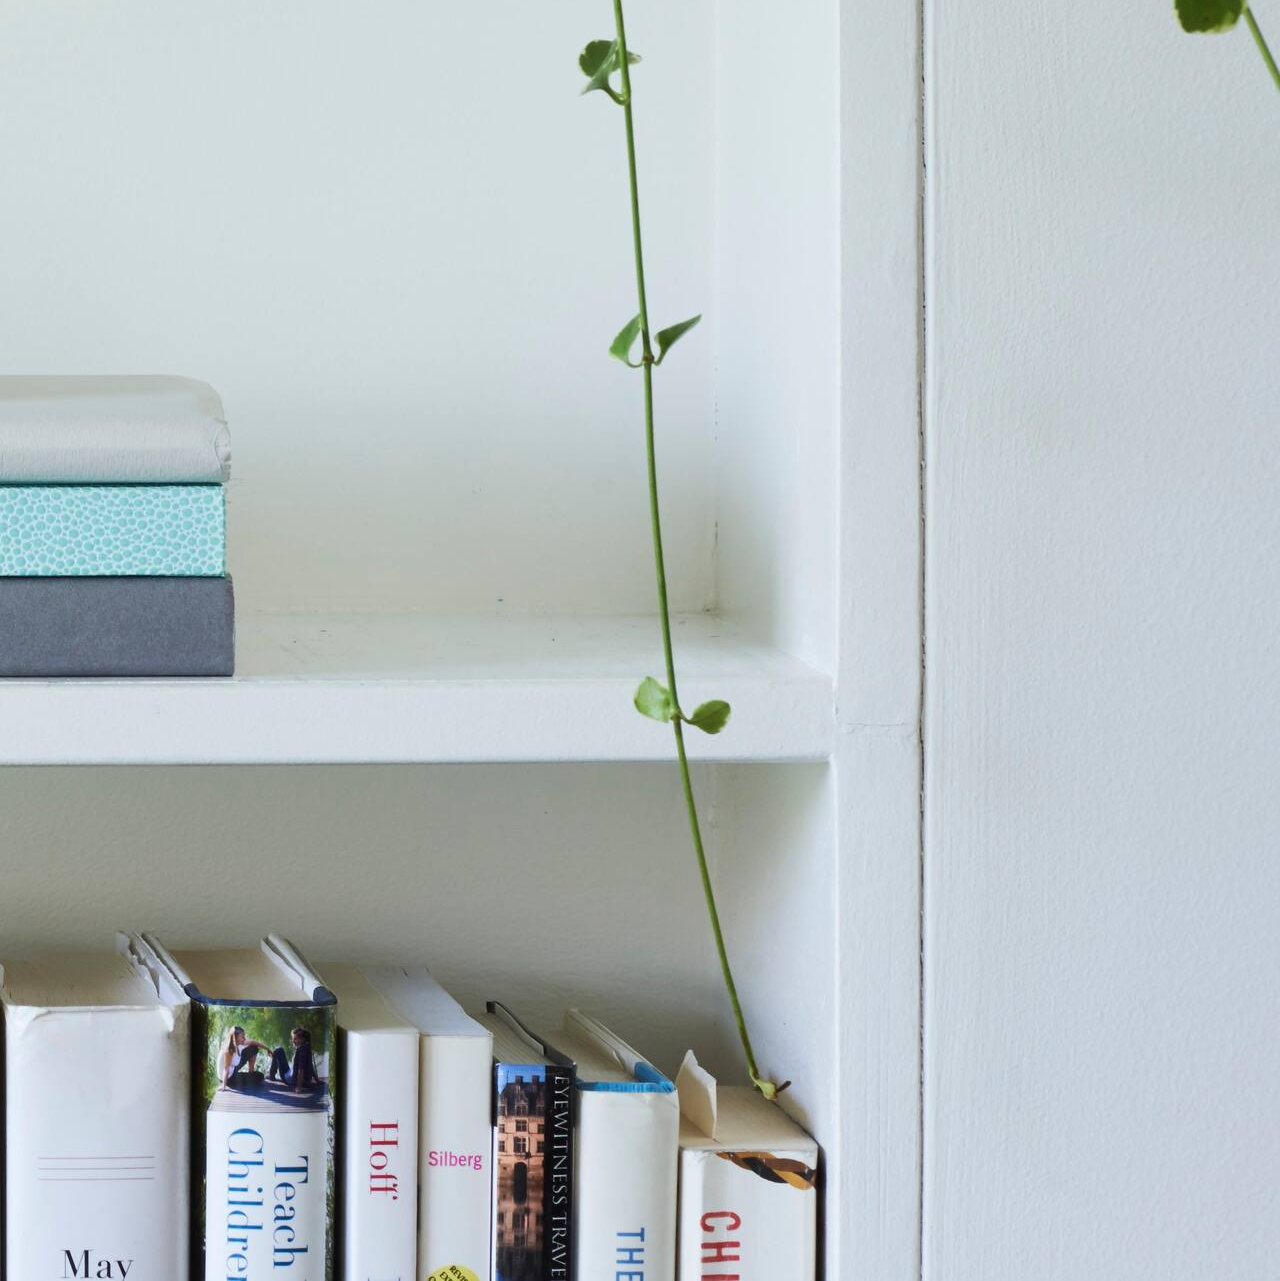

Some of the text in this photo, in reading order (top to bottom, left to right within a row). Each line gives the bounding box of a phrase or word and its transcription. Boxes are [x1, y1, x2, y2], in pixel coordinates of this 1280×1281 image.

[369, 1119, 399, 1200] Hoff
[428, 1149, 482, 1171] Silberg
[551, 1077, 569, 1281] EYEWITNESS TRAVE
[273, 1155, 309, 1268] Teach
[61, 1249, 134, 1281] May
